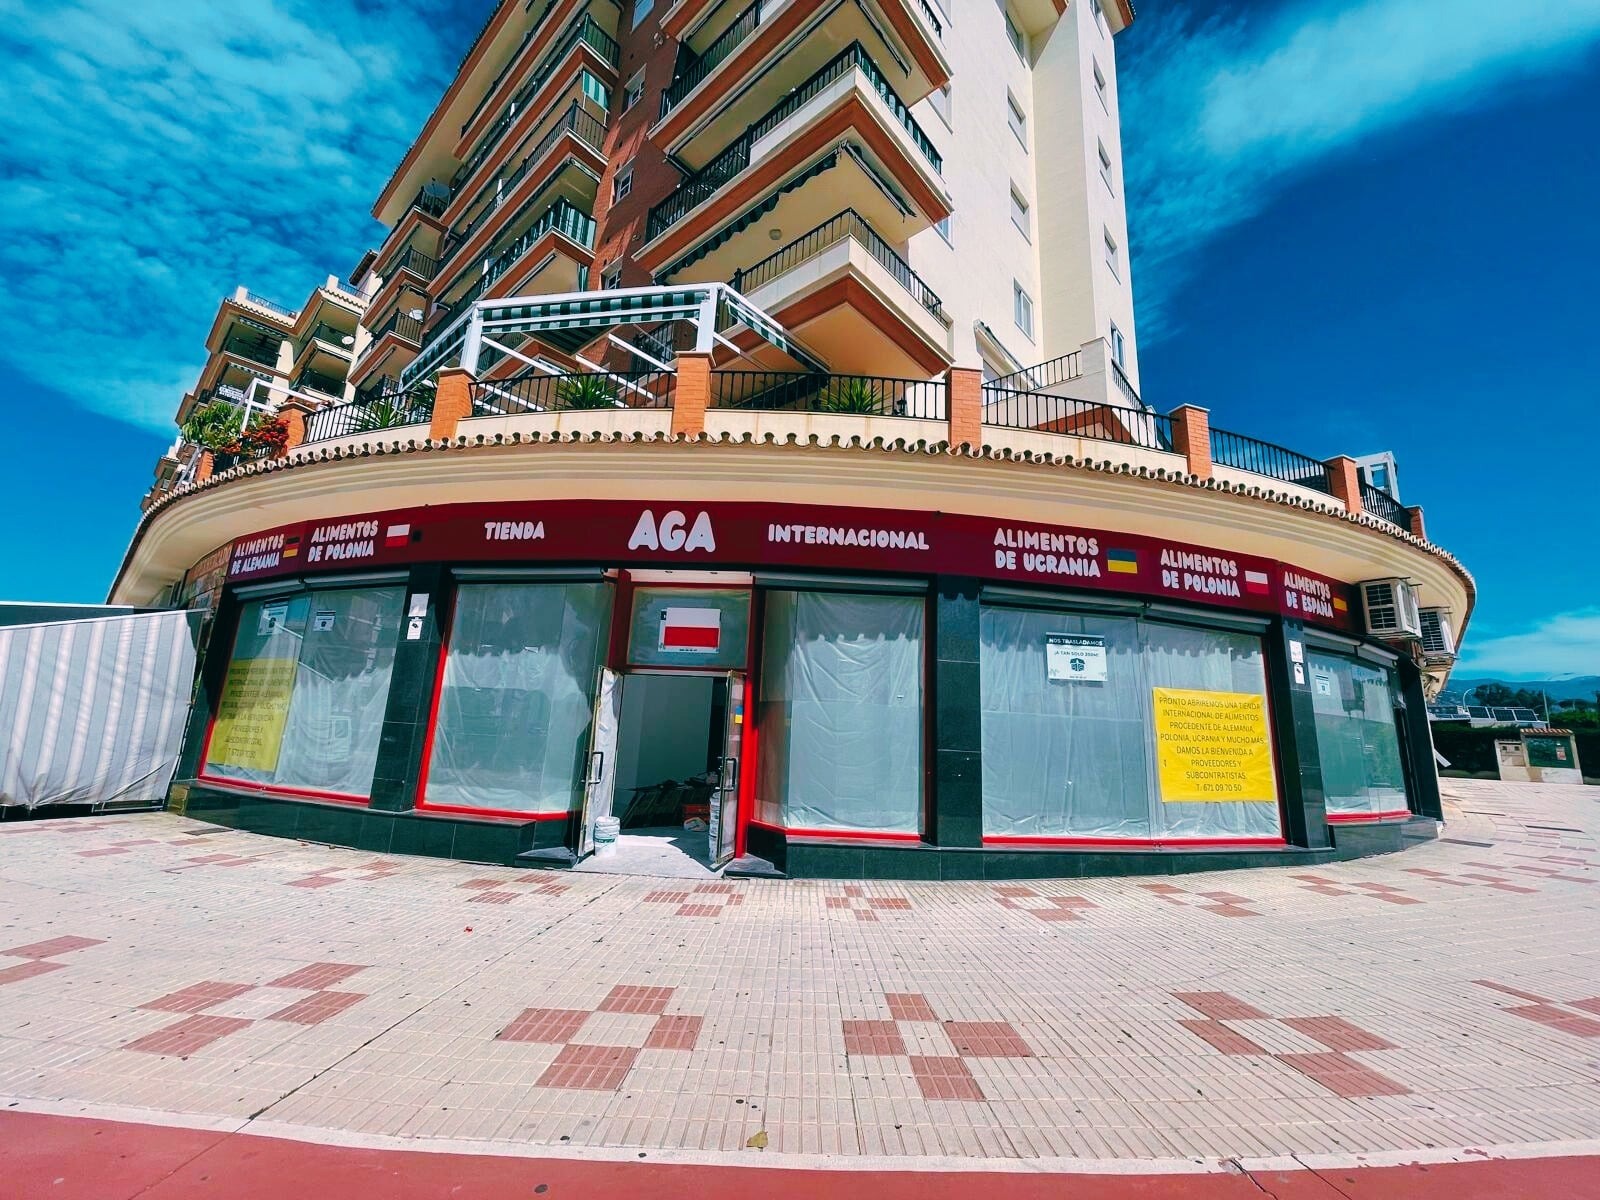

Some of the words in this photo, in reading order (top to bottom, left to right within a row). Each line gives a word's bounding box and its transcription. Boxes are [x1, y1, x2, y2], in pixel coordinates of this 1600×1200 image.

[310, 520, 379, 544] ALIMENTOS
[484, 520, 545, 541] TIENDA
[628, 509, 716, 552] AGA
[768, 523, 930, 551] INTERNACIONAL
[993, 527, 1099, 556] ALIMENTOS
[233, 533, 284, 557] ALIMENTOS
[308, 545, 323, 562] DE
[324, 540, 375, 561] POLONIA
[230, 559, 242, 576] DE
[242, 552, 281, 573] ALEMANIA
[994, 549, 1017, 571] DE
[1023, 552, 1101, 578] UCRANIA
[1160, 548, 1239, 578] ALIMENTOS
[1161, 569, 1180, 590] DE
[1184, 572, 1241, 598] POLONIA
[1283, 570, 1331, 600] ALIMENTOS
[1285, 590, 1299, 610] DE
[1301, 592, 1335, 619] ESPAÑA
[1159, 696, 1187, 706] PRONTO
[1187, 698, 1224, 709] ABRIREMOS
[1225, 700, 1238, 709] UNA
[1162, 709, 1214, 719] INTERNACIONAL
[1214, 711, 1224, 720] DE
[1224, 712, 1260, 722] ALIMENTOS
[1169, 721, 1212, 731] PROCEDENTE
[1213, 722, 1222, 731] DE
[1176, 745, 1201, 755] DAMOS
[1201, 747, 1210, 755] LA
[1210, 747, 1248, 756] BIENVENIDA
[1248, 748, 1254, 757] A
[1192, 734, 1221, 743] UCRANIA
[1221, 735, 1226, 743] Y
[1226, 735, 1251, 744] MUCHO
[1190, 759, 1237, 768] PROVEEDORES
[1237, 760, 1242, 768] Y
[1203, 783, 1214, 792] 671
[1215, 784, 1224, 792] 09
[1225, 784, 1233, 792] 70
[1233, 784, 1242, 792] 50
